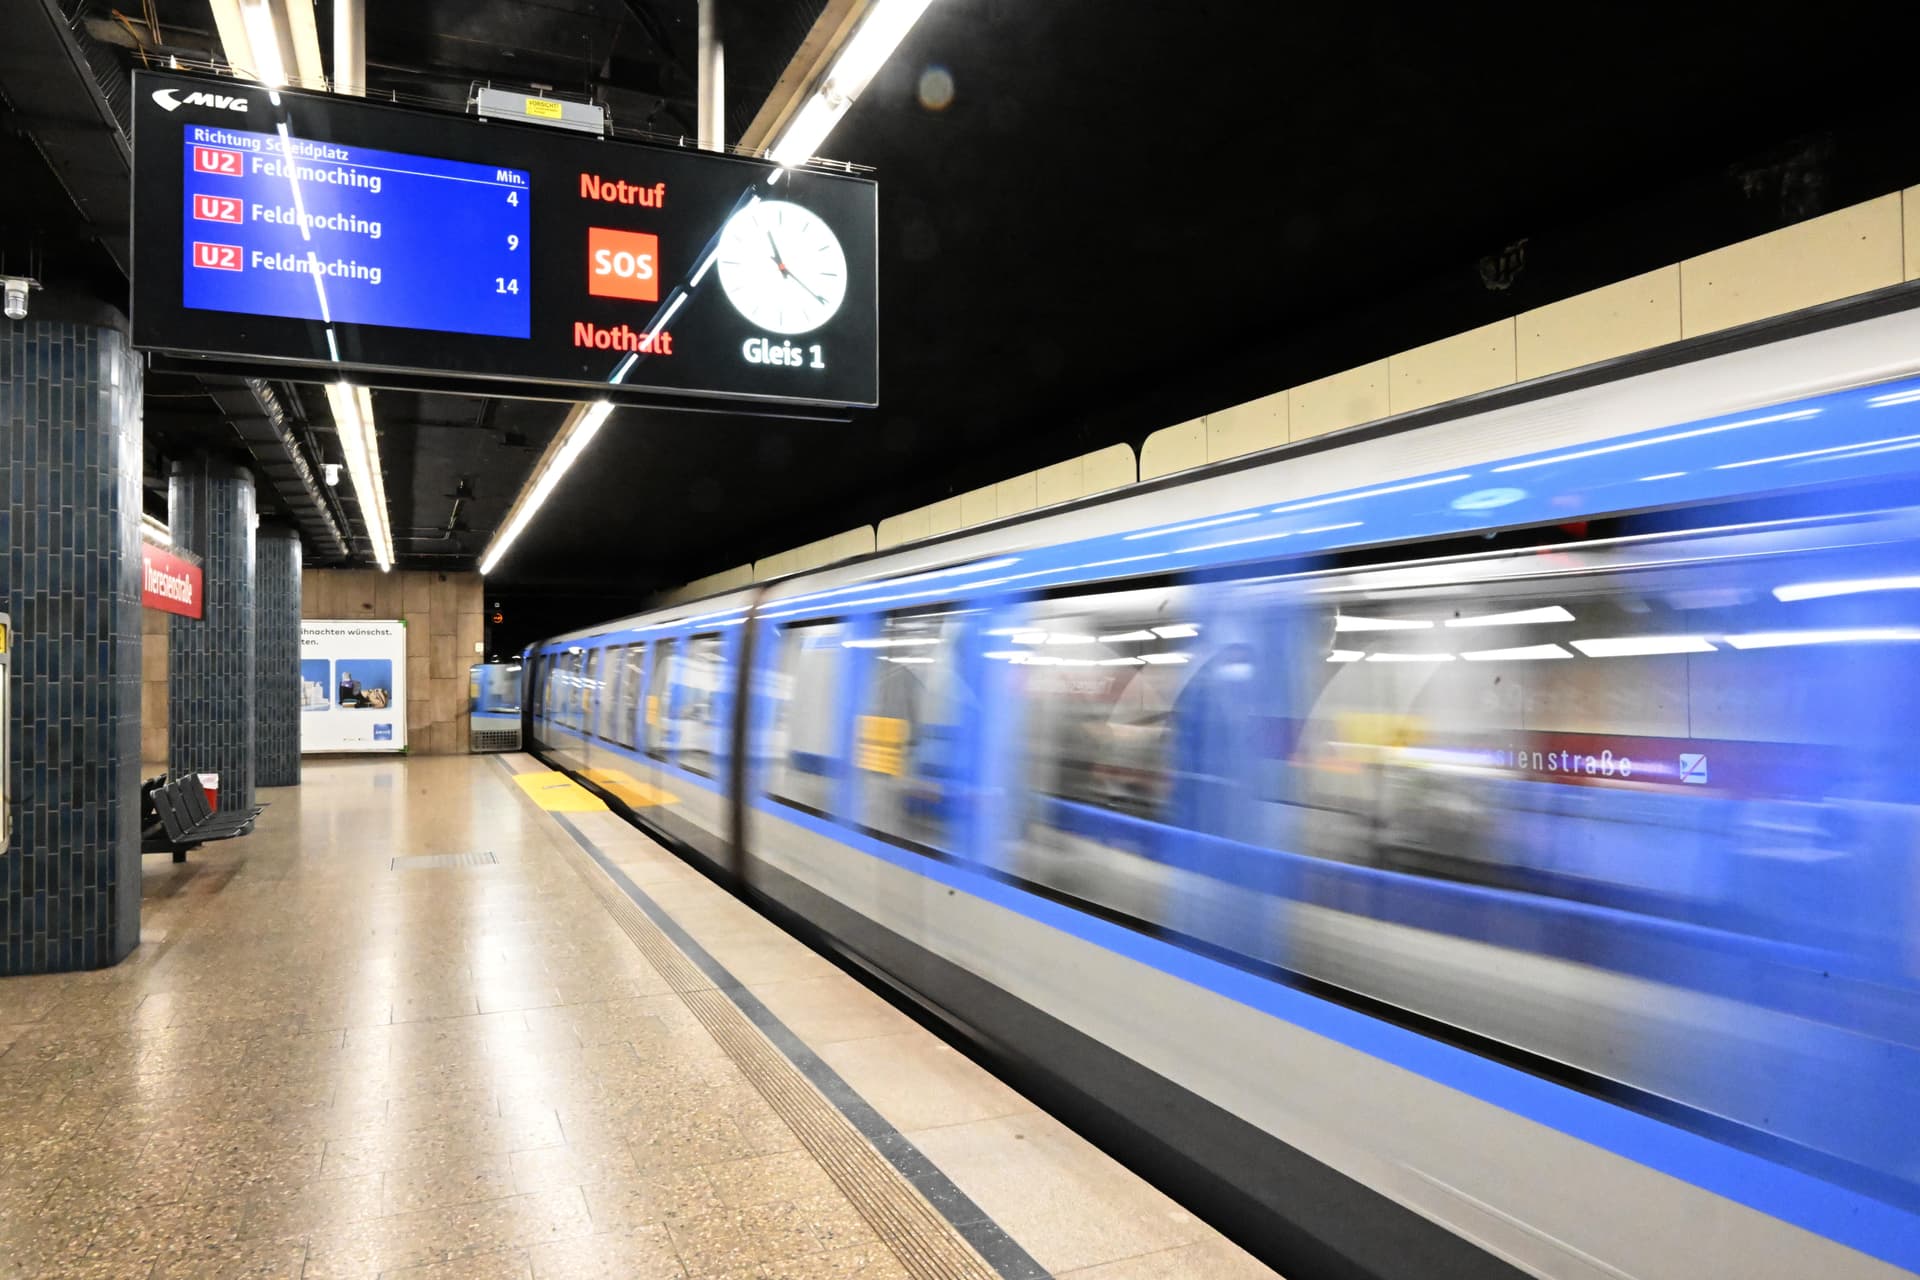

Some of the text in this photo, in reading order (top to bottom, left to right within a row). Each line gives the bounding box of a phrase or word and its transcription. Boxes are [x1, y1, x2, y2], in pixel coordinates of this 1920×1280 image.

[182, 91, 248, 112] MVG
[194, 128, 261, 152] Richtung
[201, 151, 236, 173] U2
[506, 191, 519, 208] 4
[496, 169, 526, 185] Min.
[580, 173, 665, 208] Notruf
[201, 198, 236, 220] U2
[506, 234, 519, 252] 9
[201, 246, 519, 295] U2 Feldmoching 14
[594, 248, 654, 280] SOS
[574, 321, 673, 356] Nothalt
[743, 338, 825, 369] Gleis 1
